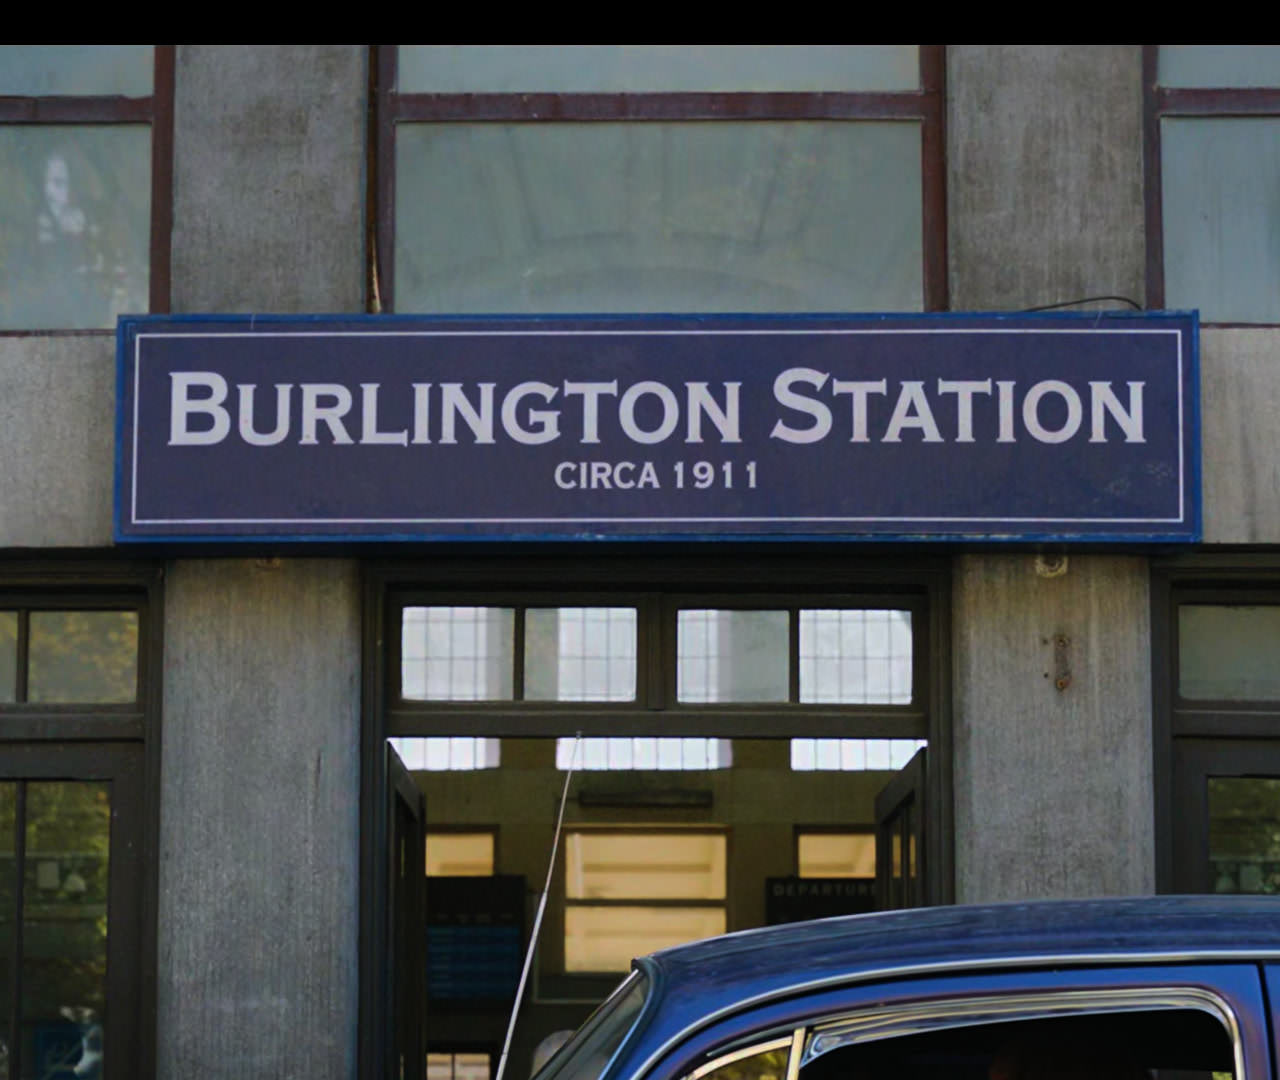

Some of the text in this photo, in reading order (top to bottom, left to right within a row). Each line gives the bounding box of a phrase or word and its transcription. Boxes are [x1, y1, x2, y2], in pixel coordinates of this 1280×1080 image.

[167, 367, 1146, 447] BURLINGTON STATION
[554, 461, 757, 489] CIRCA 1911
